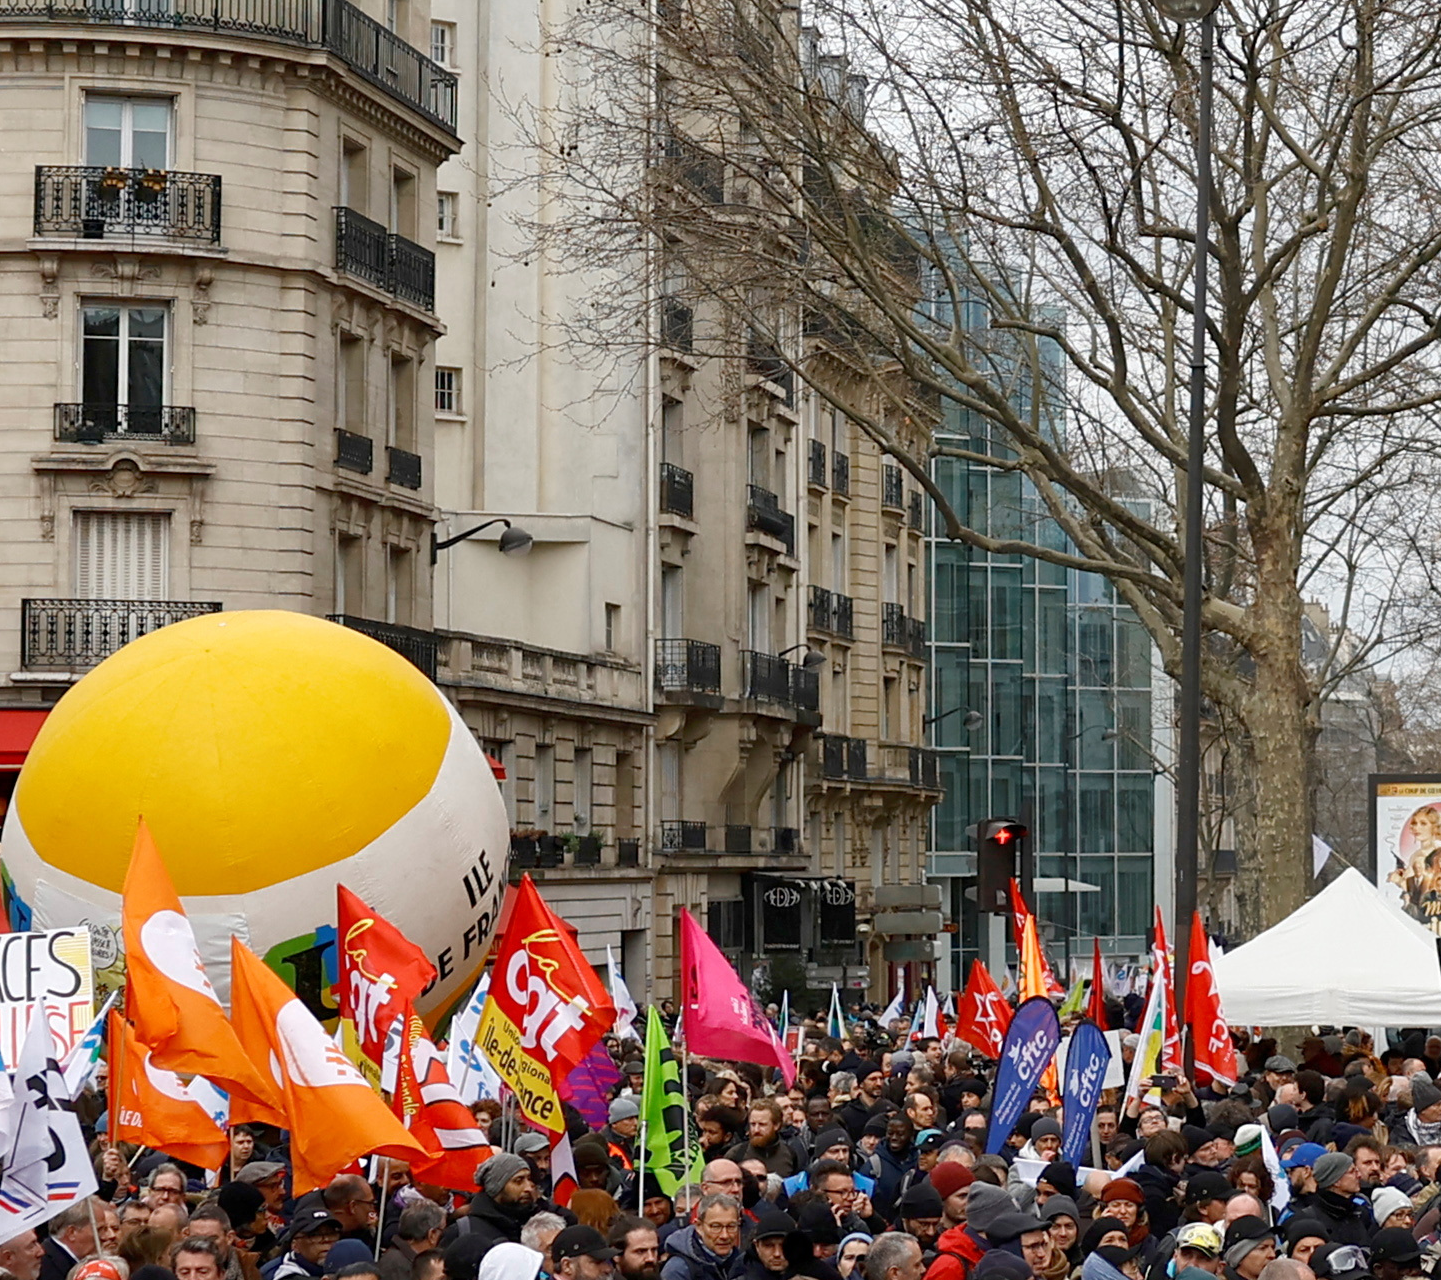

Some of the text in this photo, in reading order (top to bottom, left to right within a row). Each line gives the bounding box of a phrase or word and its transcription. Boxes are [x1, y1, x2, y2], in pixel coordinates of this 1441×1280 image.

[462, 849, 493, 908] ILE
[345, 954, 396, 1042] gt
[506, 949, 591, 1062] cgt
[1017, 1029, 1048, 1081] cftc
[1079, 1053, 1101, 1107] cftc
